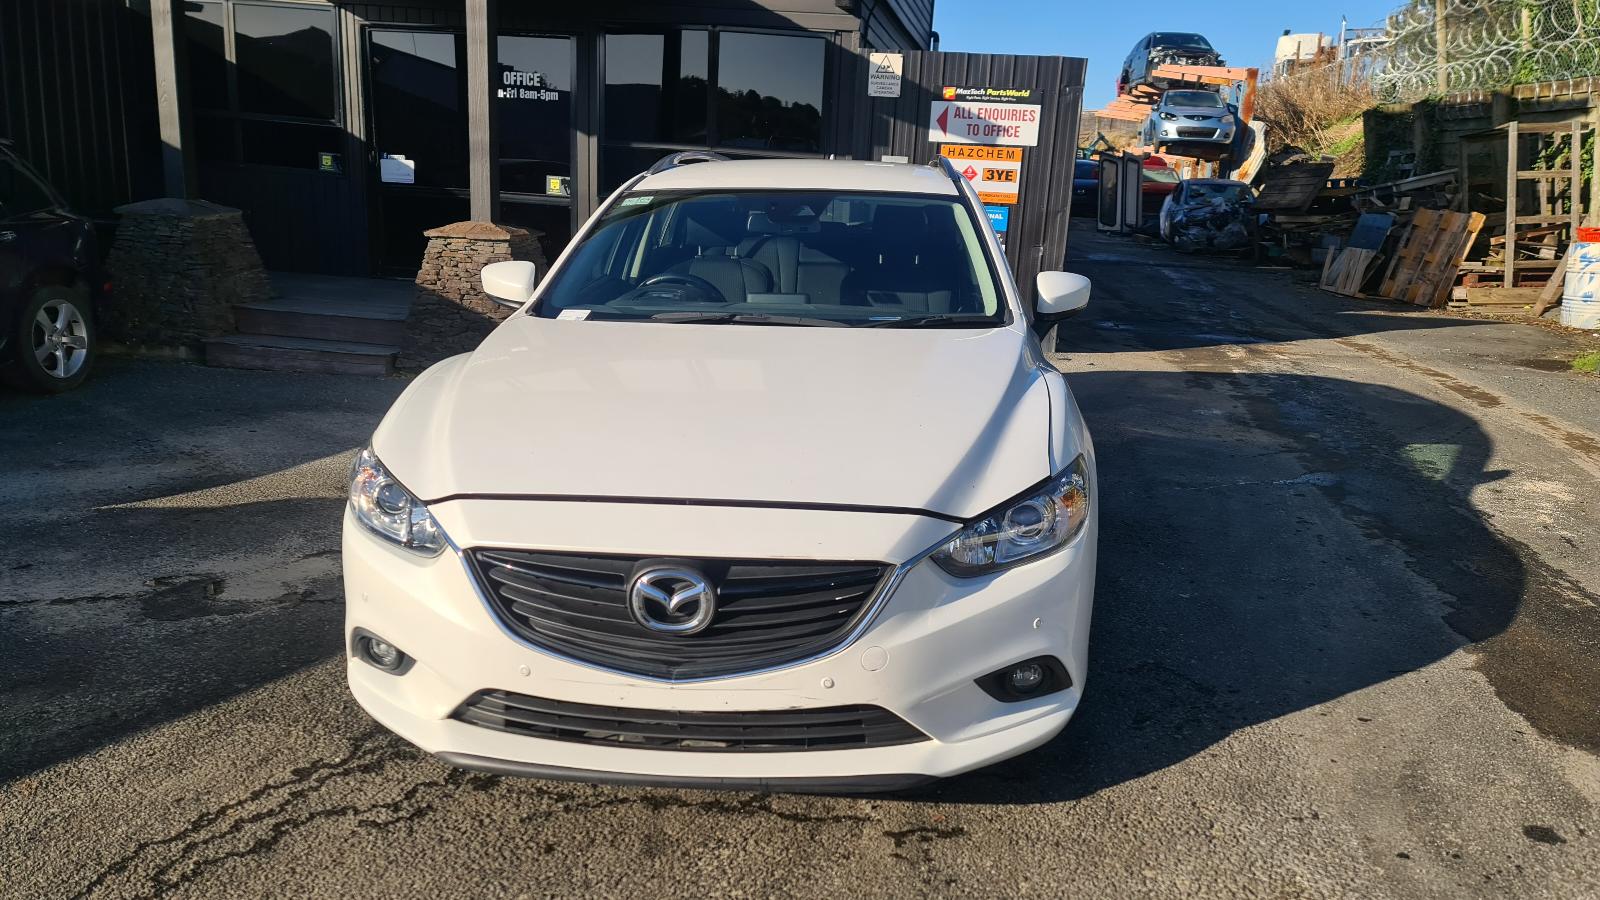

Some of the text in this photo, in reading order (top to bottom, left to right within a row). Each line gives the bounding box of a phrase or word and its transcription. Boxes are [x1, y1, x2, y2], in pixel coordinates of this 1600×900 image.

[503, 71, 541, 86] OFFICE
[497, 87, 559, 101] n-Fri 8am-5pm
[986, 89, 1030, 97] PartsWorld
[954, 107, 1036, 122] ALL ENQUIRIES
[967, 123, 1020, 138] TO OFFICE
[947, 147, 1015, 160] HAZCHEM
[986, 169, 1013, 181] 3YE
